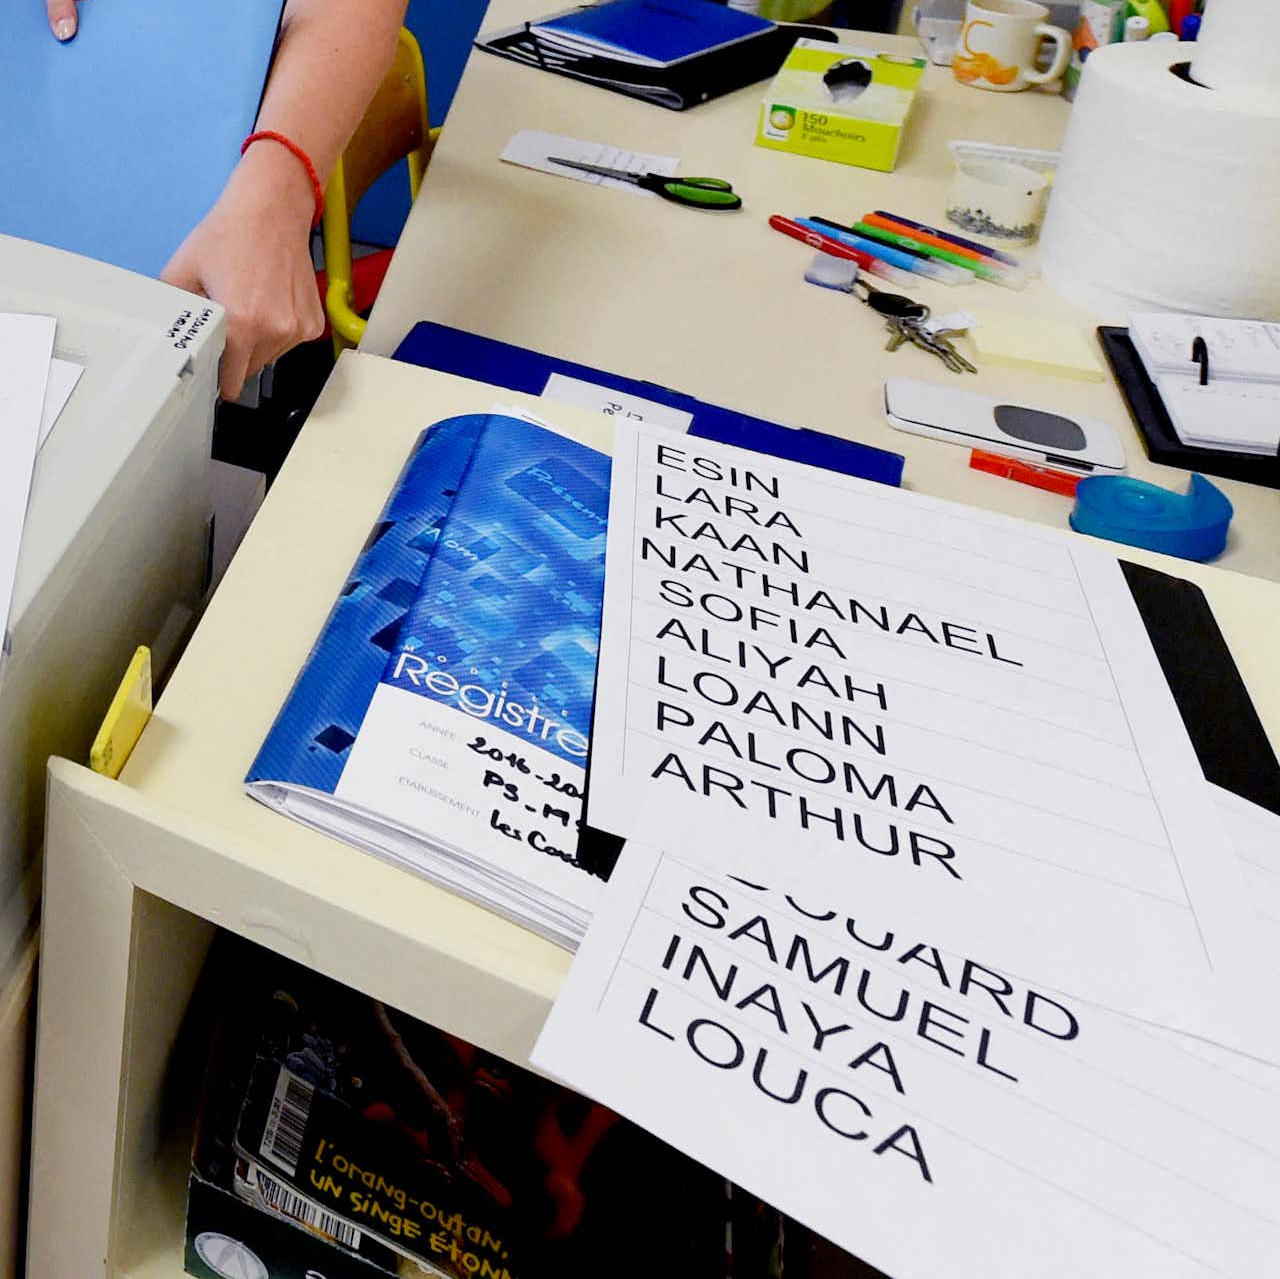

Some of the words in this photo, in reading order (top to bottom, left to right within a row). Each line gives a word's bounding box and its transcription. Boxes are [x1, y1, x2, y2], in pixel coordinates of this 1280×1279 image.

[803, 112, 828, 126] 150
[657, 444, 779, 499] ESIN
[657, 475, 803, 537] LARA
[655, 506, 809, 573] KAAN
[642, 537, 1024, 667] NATHANAEL
[659, 579, 847, 660] SOFIA
[393, 651, 589, 758] Registre
[656, 618, 888, 711] ALIYAH
[658, 655, 886, 756] LOANN
[657, 700, 955, 825] PALOMA
[651, 753, 963, 880] ARTHUR
[661, 934, 907, 1095] INAYA
[681, 885, 1020, 1083] SAMUEL
[637, 987, 934, 1185] LOUCA
